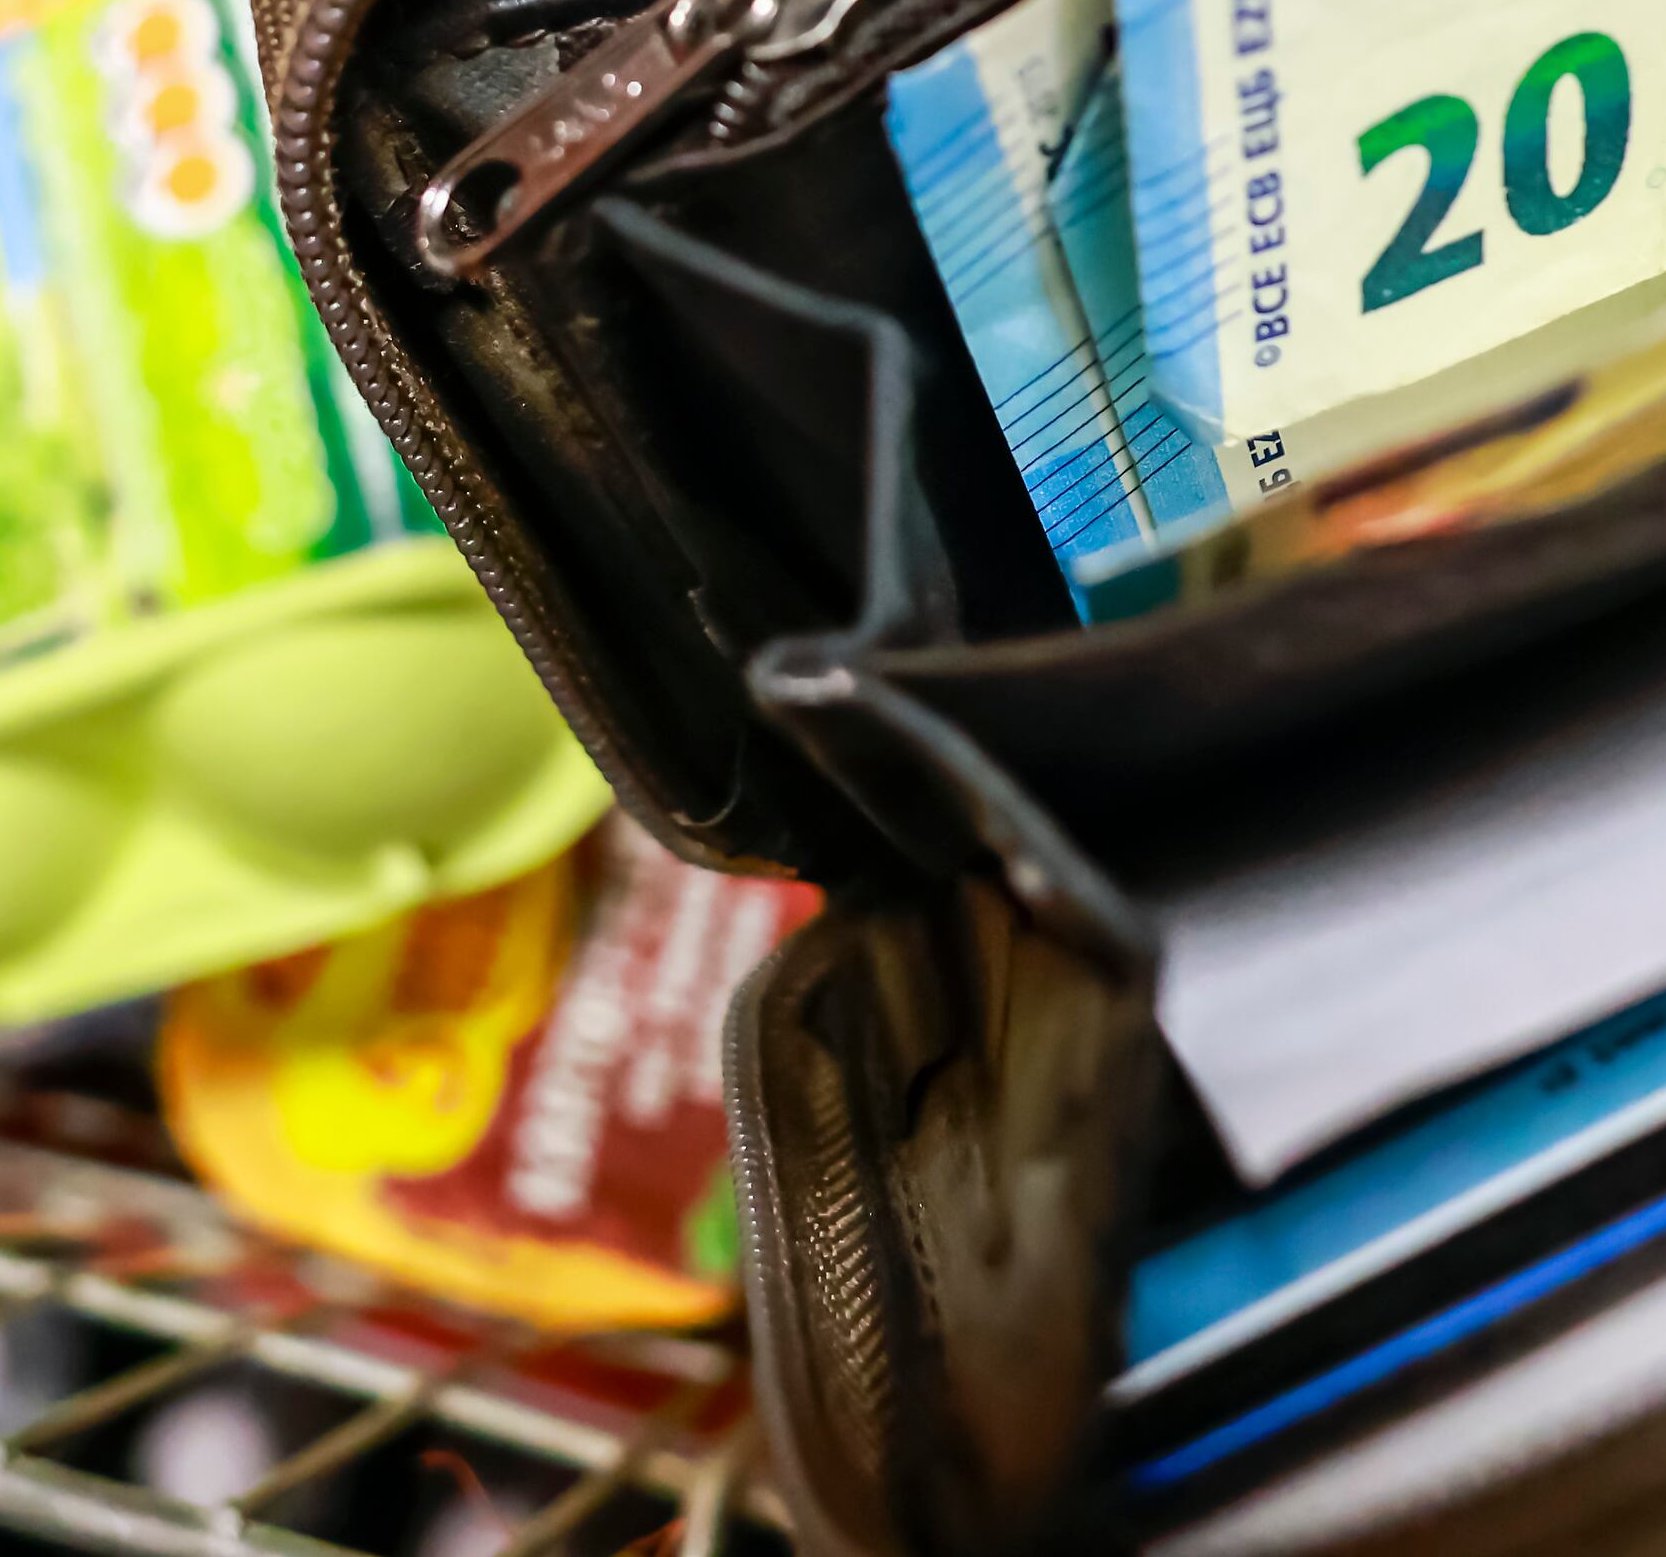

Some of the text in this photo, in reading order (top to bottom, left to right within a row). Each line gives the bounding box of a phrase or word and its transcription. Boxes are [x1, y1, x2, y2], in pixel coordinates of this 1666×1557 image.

[1245, 171, 1286, 255] ECB
[1355, 30, 1632, 315] 20
[1246, 430, 1285, 468] EZ
